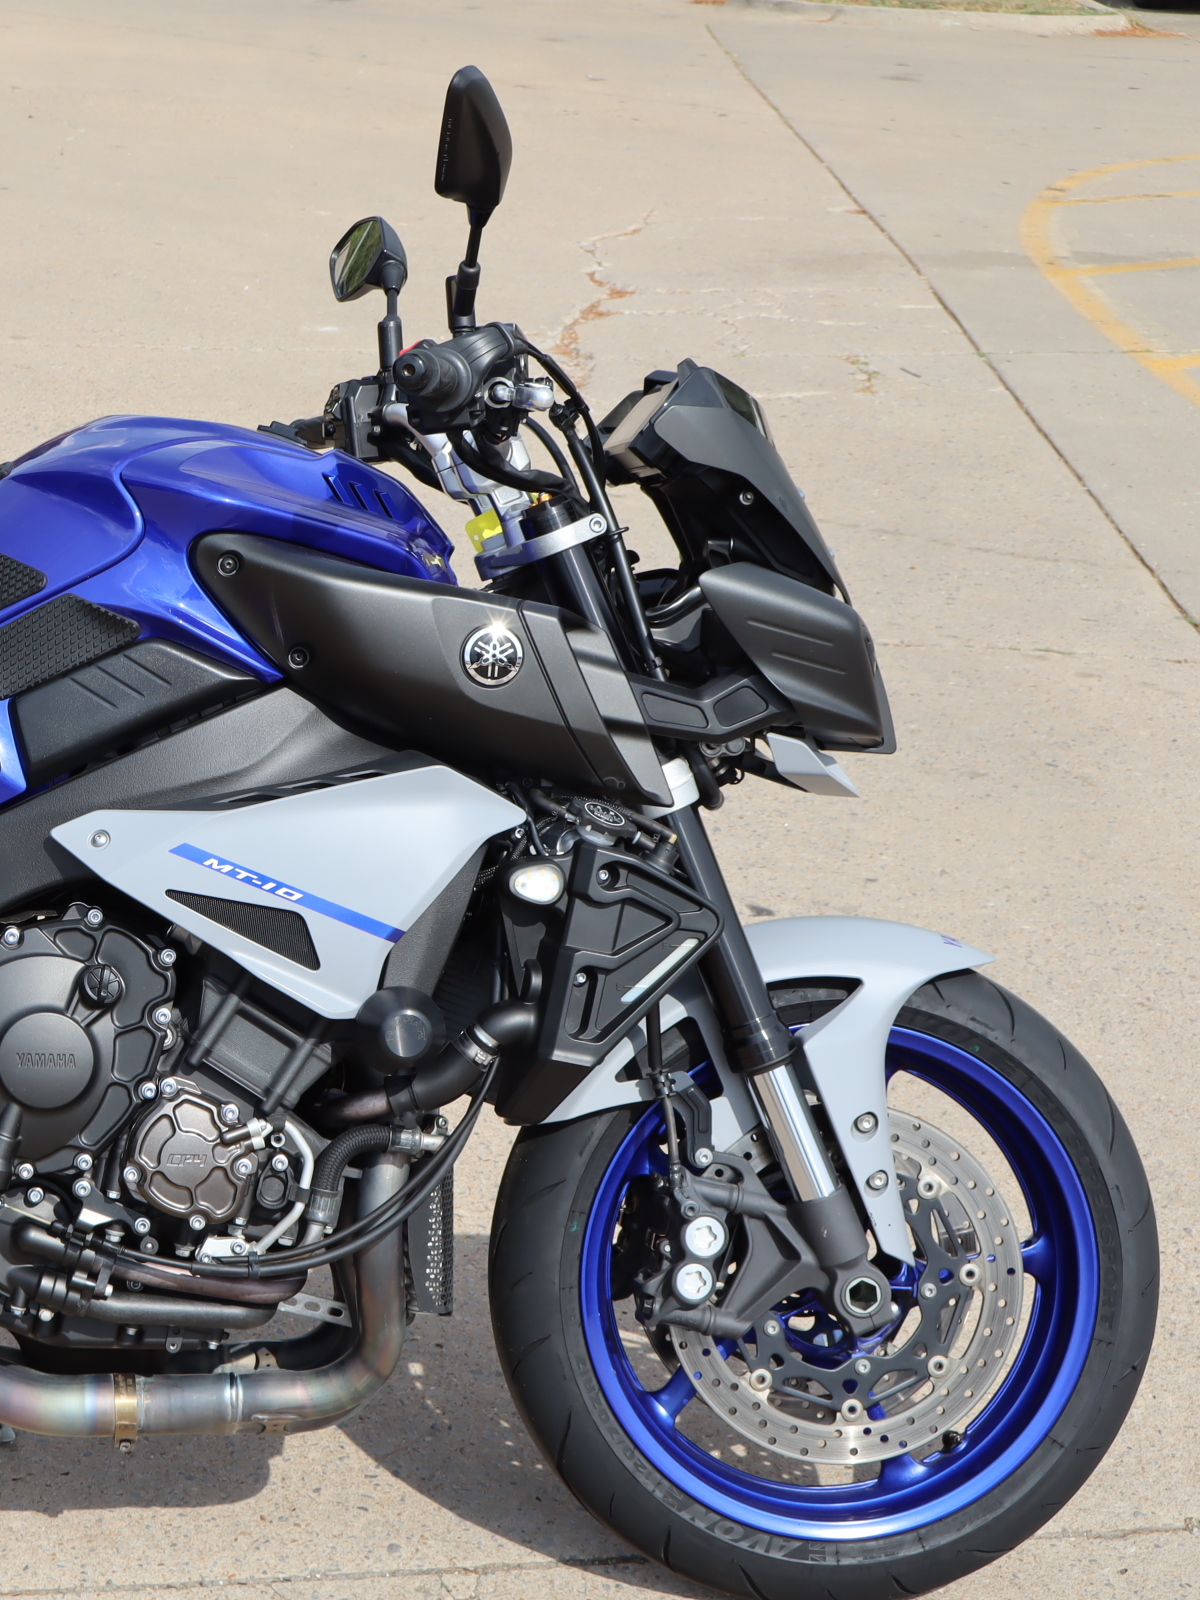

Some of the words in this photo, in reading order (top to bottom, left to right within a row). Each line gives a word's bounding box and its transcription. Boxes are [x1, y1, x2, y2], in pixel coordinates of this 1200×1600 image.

[202, 858, 304, 901] MT-10
[16, 1052, 77, 1069] YAMAHA
[166, 1153, 207, 1168] CP4
[679, 1499, 801, 1558] AVON
